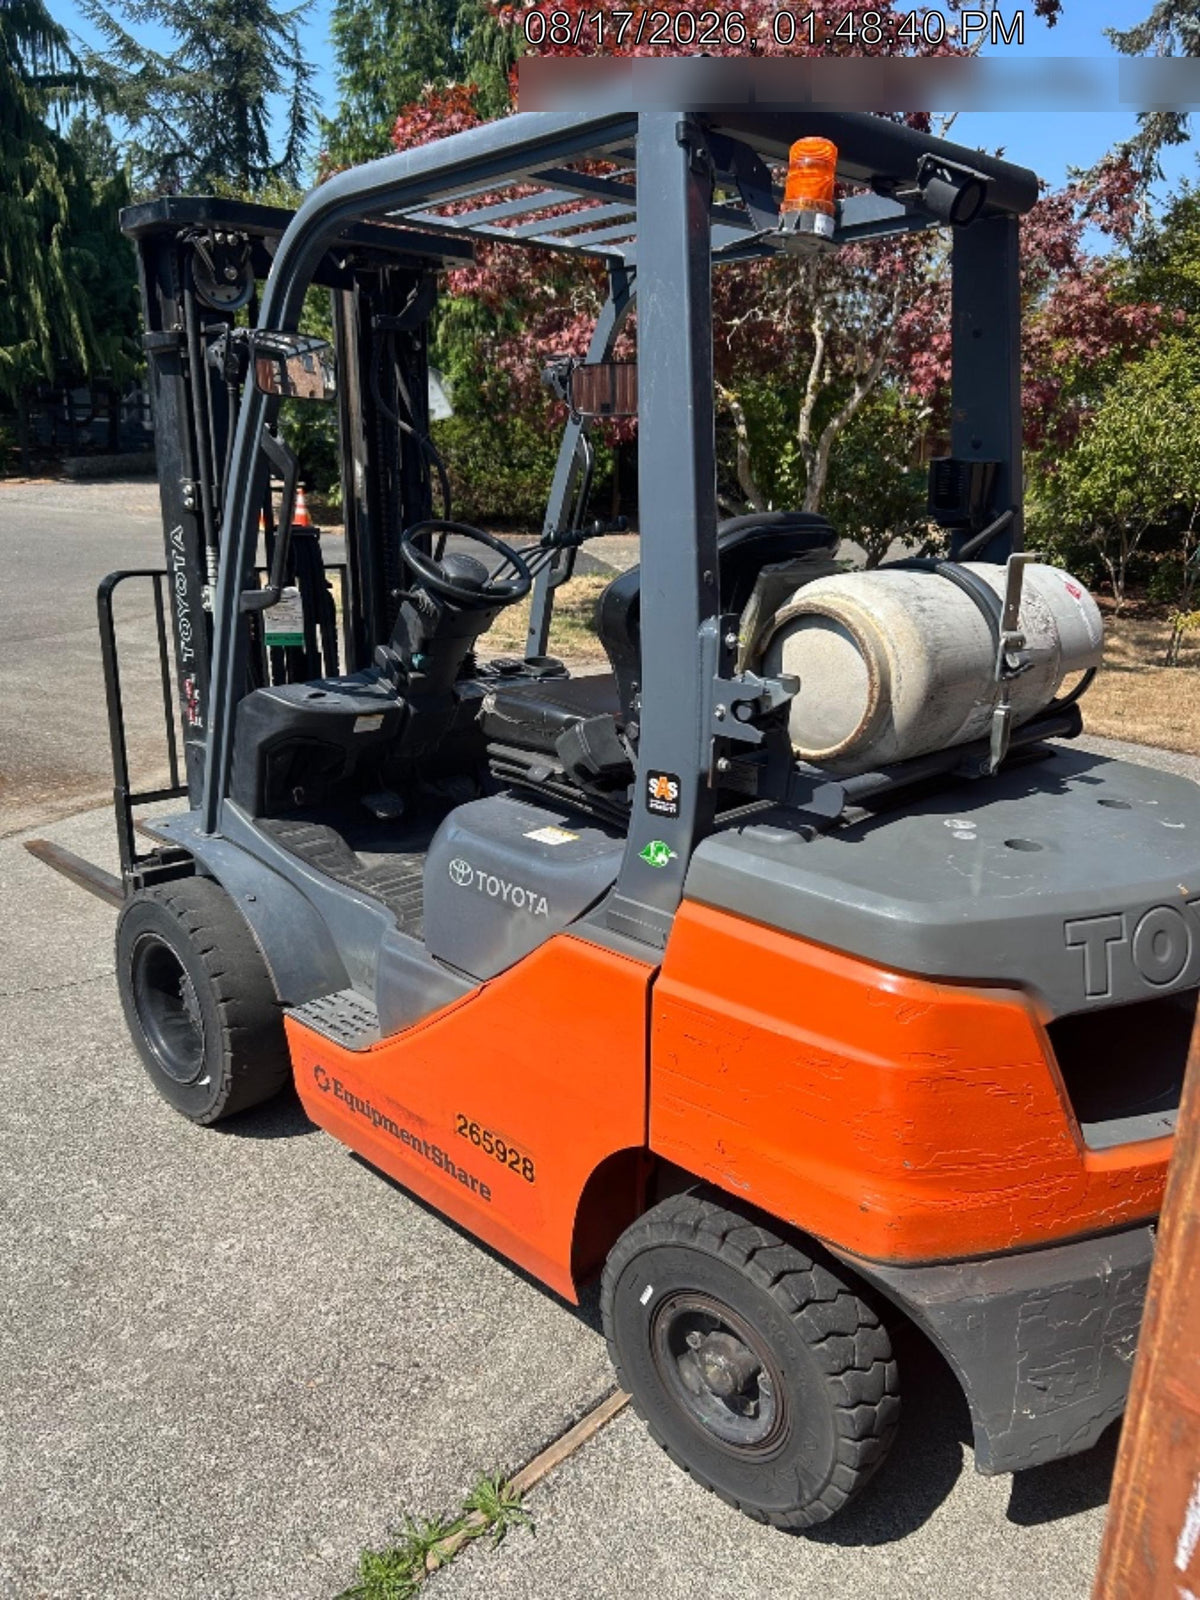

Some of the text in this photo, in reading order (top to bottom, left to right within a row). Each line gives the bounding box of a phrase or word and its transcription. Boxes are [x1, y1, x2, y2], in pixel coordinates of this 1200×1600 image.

[170, 524, 195, 662] TOYOTA
[648, 776, 679, 801] SAS
[476, 870, 549, 918] TOYOTA
[1064, 897, 1200, 1000] TO
[332, 1077, 493, 1203] EquipmentShare
[456, 1113, 536, 1183] 265928
